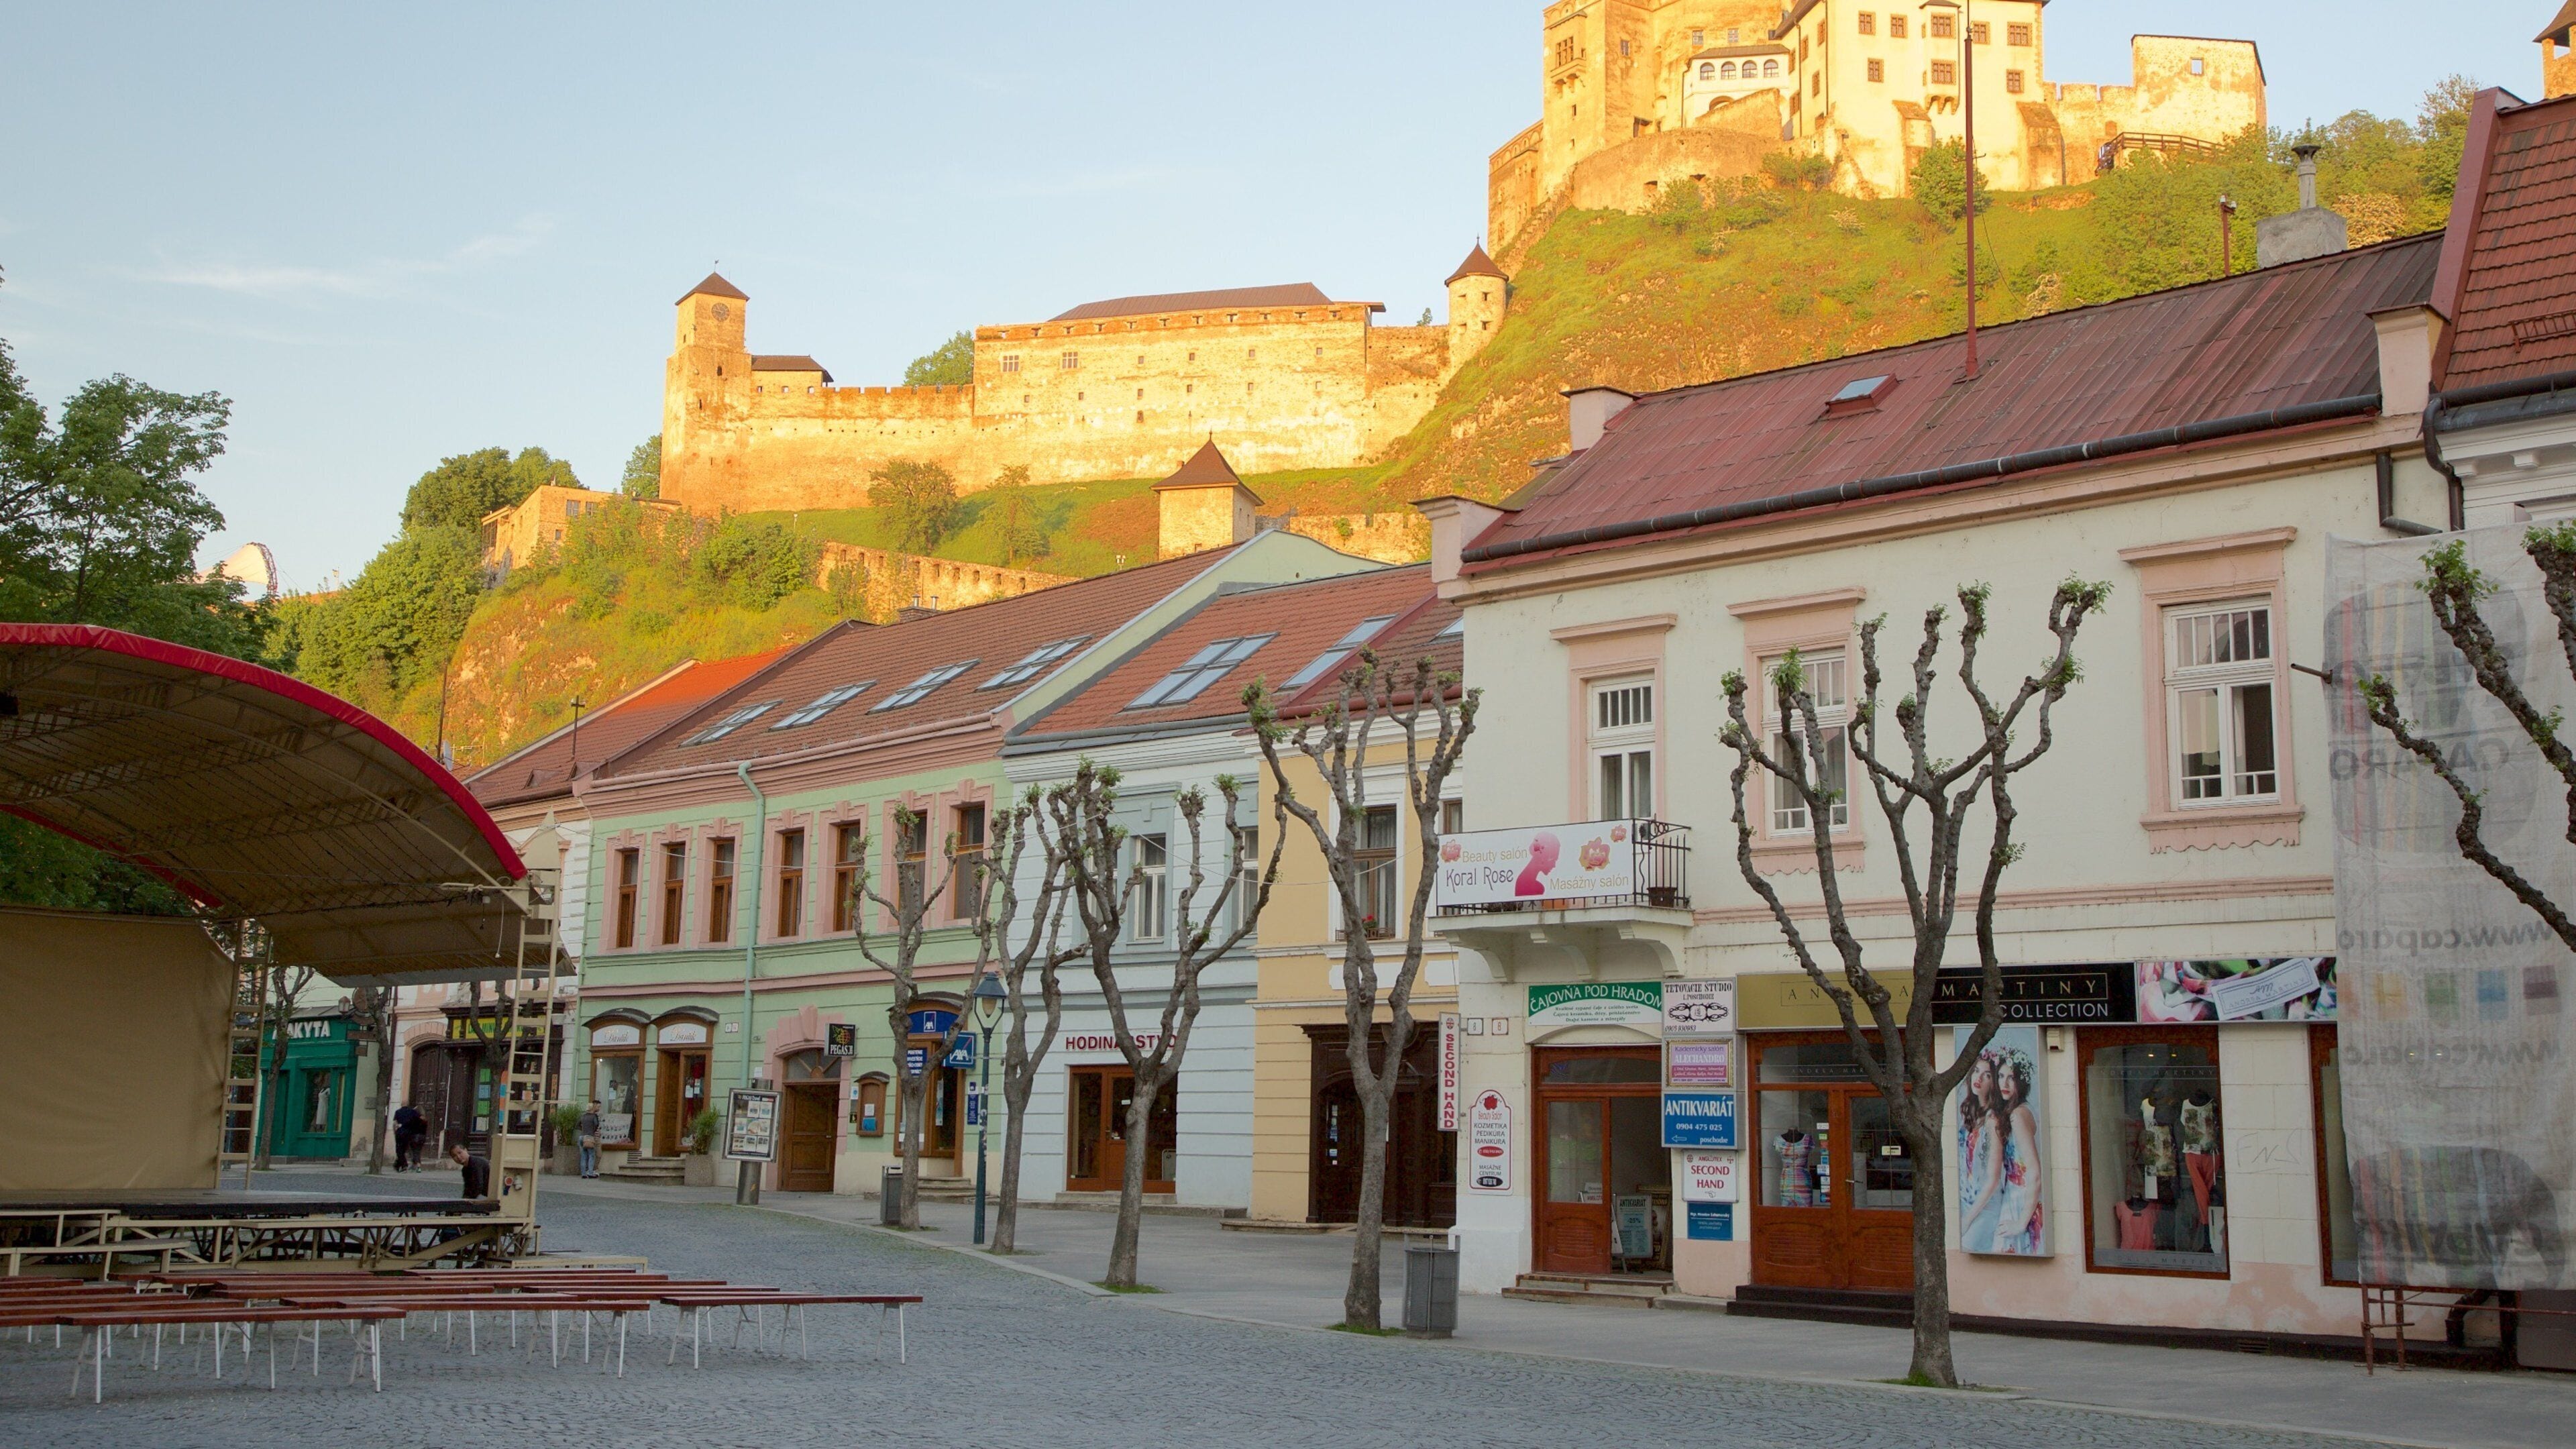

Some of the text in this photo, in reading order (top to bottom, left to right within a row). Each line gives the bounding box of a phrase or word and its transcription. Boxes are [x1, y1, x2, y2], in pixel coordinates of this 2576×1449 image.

[1462, 846, 1527, 863] Beauty salón
[1446, 867, 1513, 893] Koral Rose
[1550, 873, 1629, 890] Masážny salón
[1941, 979, 2096, 996] MATINY
[2229, 976, 2305, 1008] ANDREA MARTINY
[1529, 985, 1582, 1012] ČAJOVŇA
[1585, 985, 1608, 998] POD
[924, 1021, 934, 1030] AXA
[950, 1049, 969, 1061] AXA
[1444, 1033, 1455, 1087] SECOND
[1674, 1054, 1725, 1063] ALECHANDRO
[1444, 1092, 1454, 1128] HAND
[1665, 1095, 1733, 1117] ANTIKVARIÁT
[1690, 1165, 1729, 1175] SECOND
[1697, 1179, 1724, 1189] HAND
